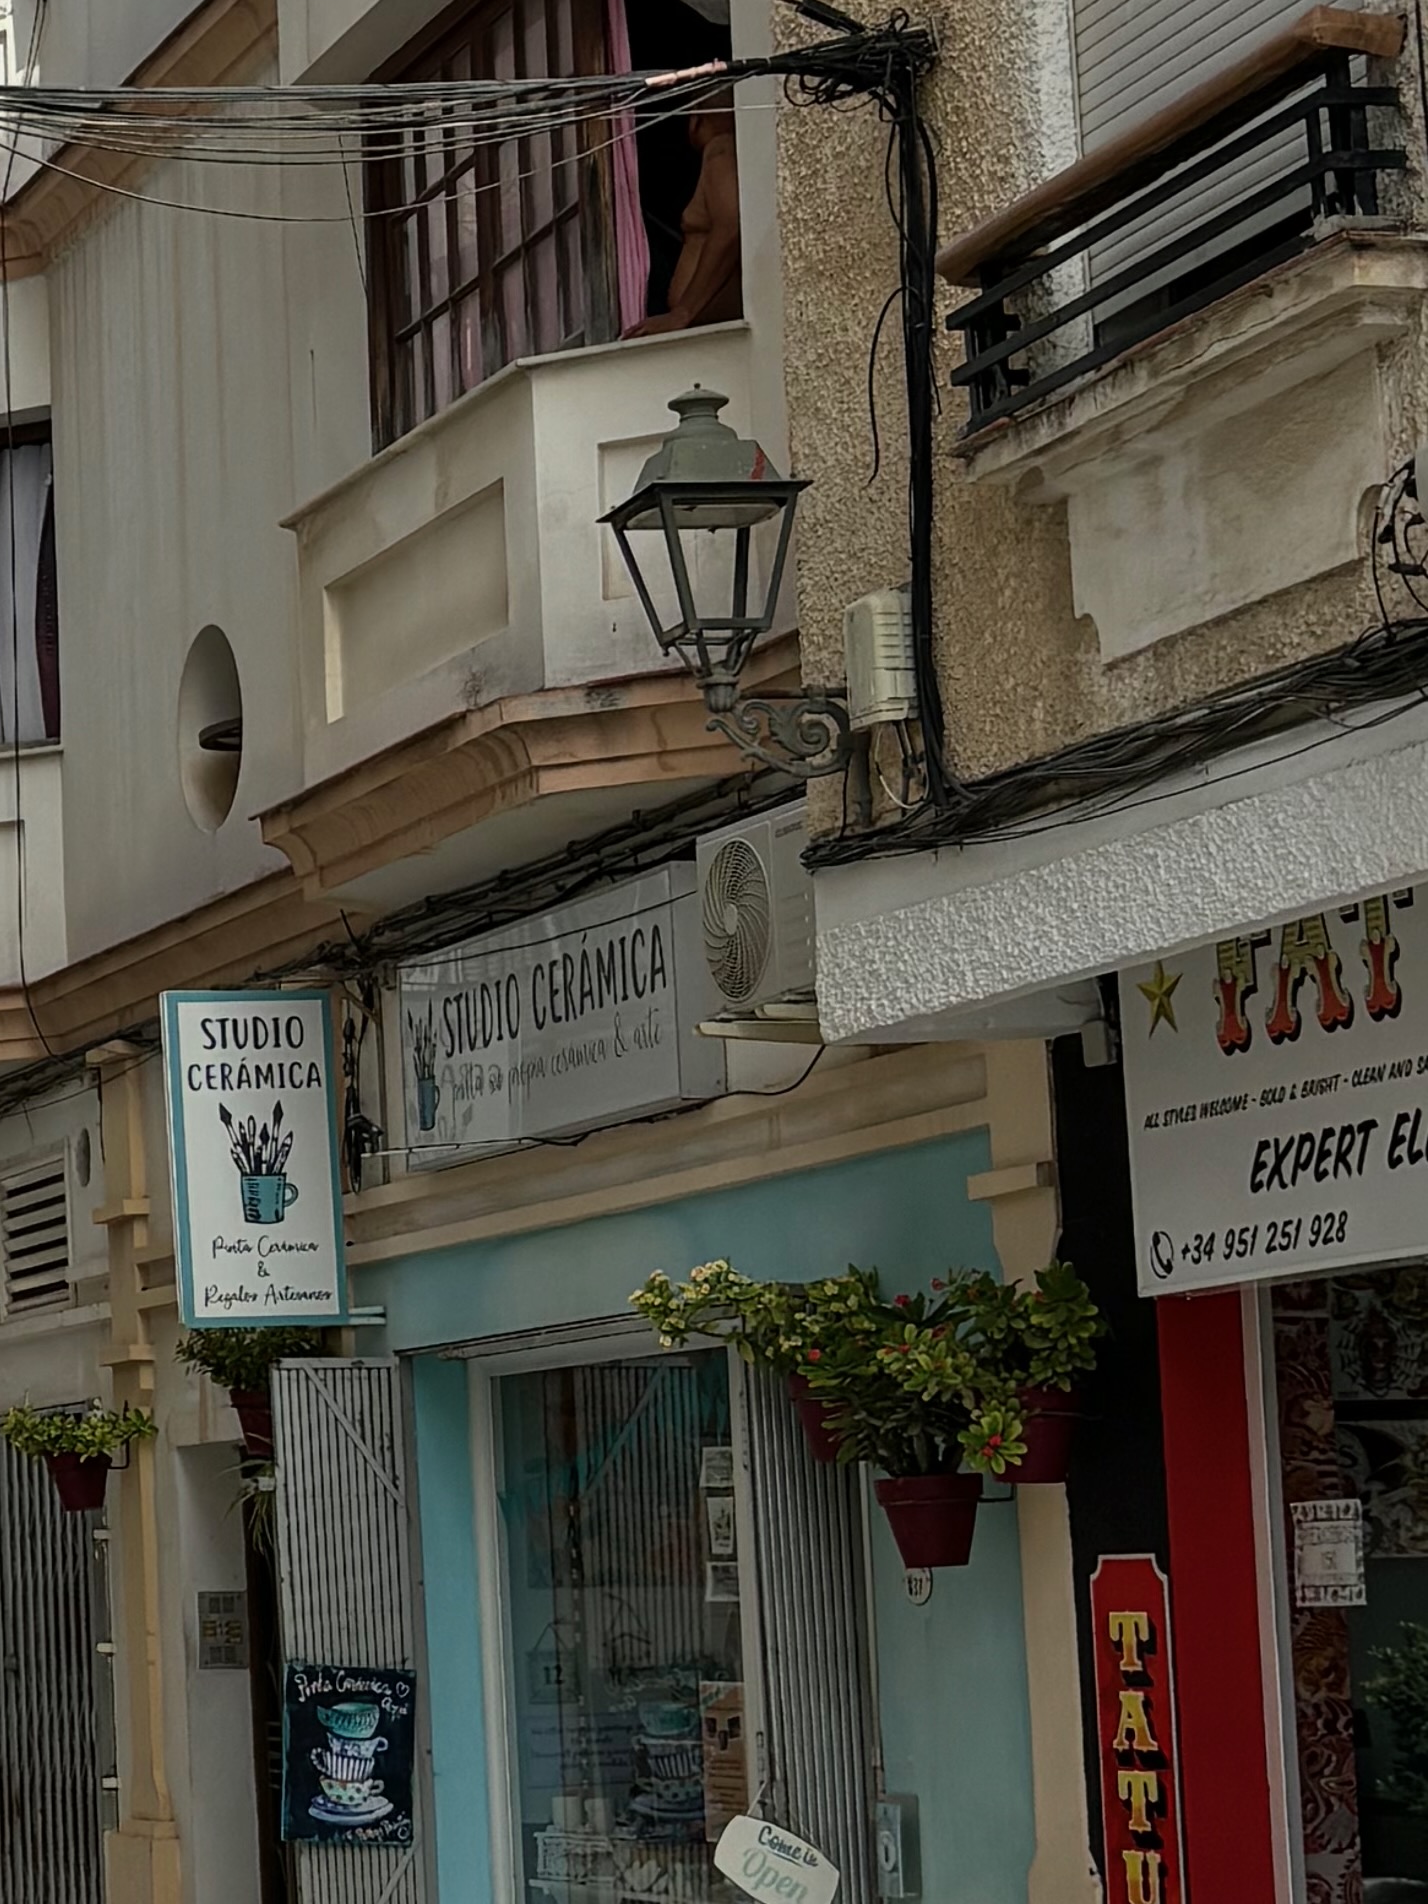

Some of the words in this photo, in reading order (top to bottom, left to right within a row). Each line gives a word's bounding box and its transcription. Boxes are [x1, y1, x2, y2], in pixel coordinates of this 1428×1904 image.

[443, 973, 520, 1058] STUDIO
[531, 924, 667, 1031] CERÁMICA
[200, 1015, 305, 1050] STUDIO
[187, 1057, 323, 1091] CERÁMICA
[1144, 1112, 1160, 1130] ALL
[1162, 1104, 1197, 1127] STYLES
[1199, 1093, 1249, 1119] WELCOME
[1300, 1073, 1342, 1099] BRIGHT
[1351, 1063, 1386, 1087] CLEAN
[1388, 1058, 1413, 1080] AND
[1249, 1118, 1379, 1194] EXPERT
[1387, 1106, 1428, 1171] EL
[1181, 1232, 1216, 1265] +34
[1222, 1224, 1259, 1260] 951
[1265, 1217, 1302, 1254] 251
[1309, 1210, 1349, 1247] 928
[257, 1261, 271, 1277] &
[757, 1824, 802, 1861] Come
